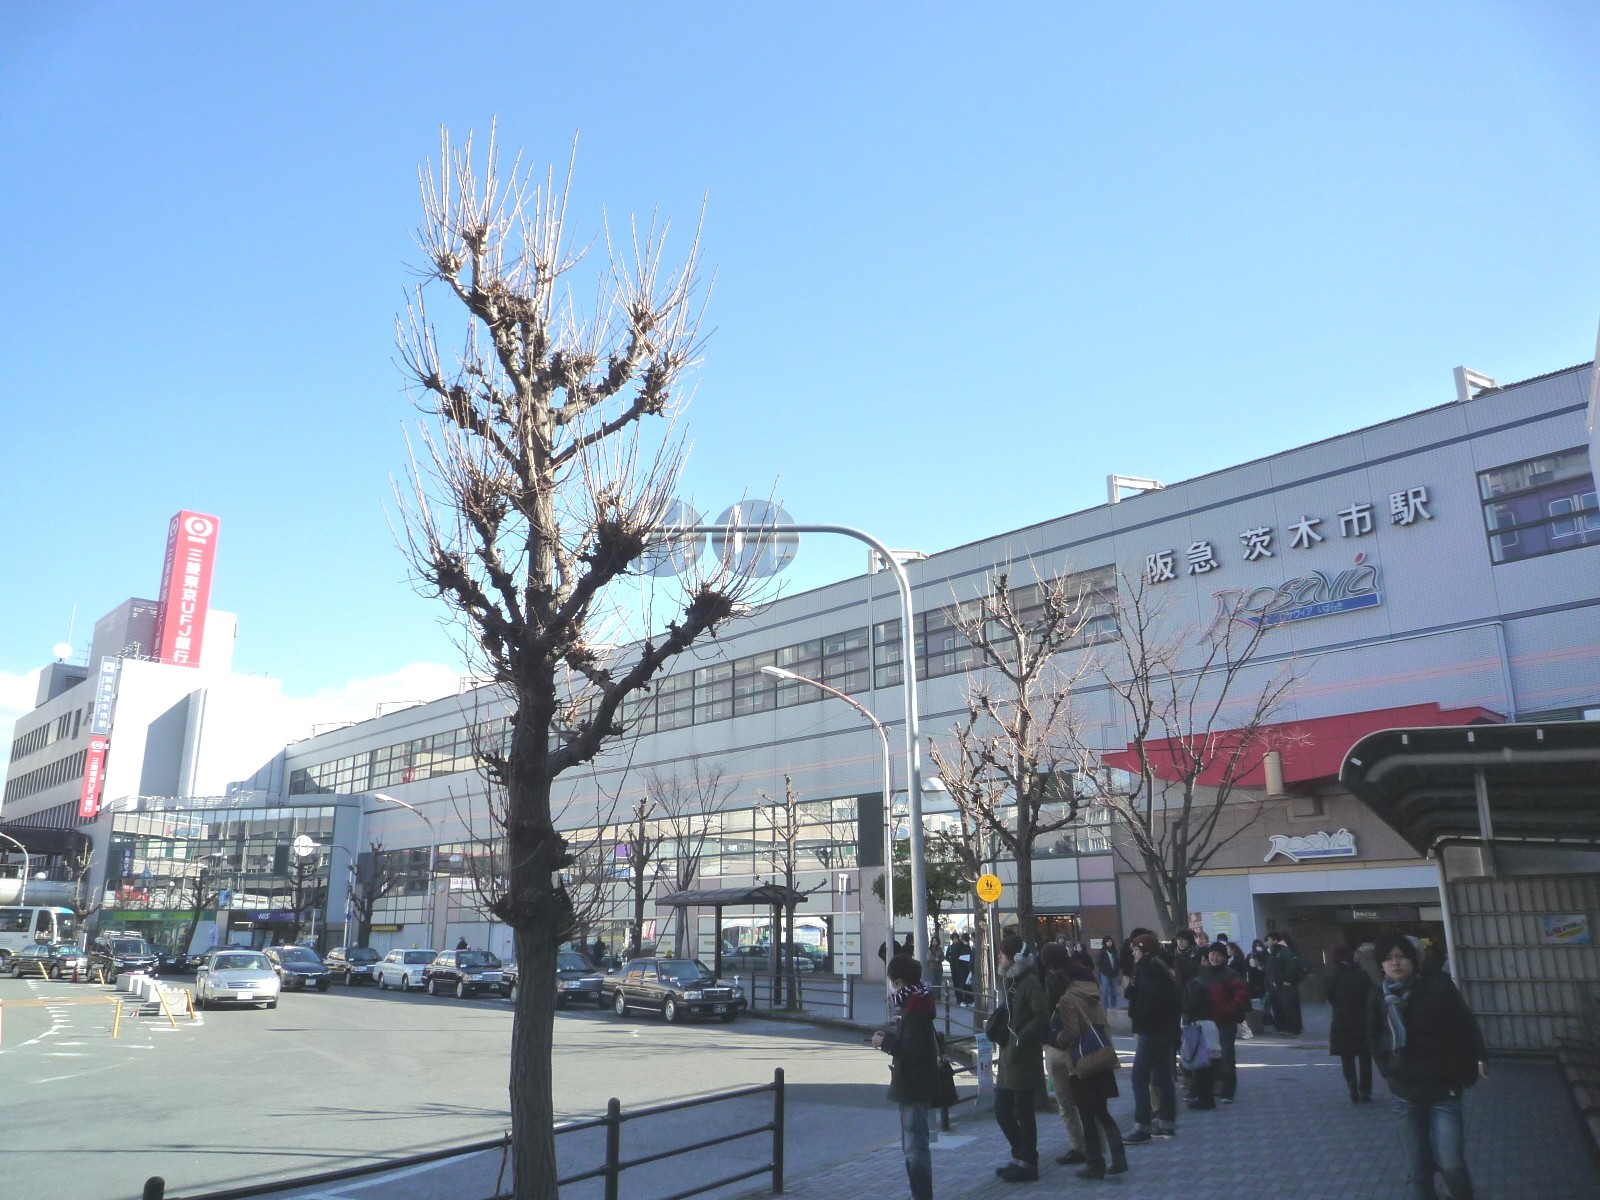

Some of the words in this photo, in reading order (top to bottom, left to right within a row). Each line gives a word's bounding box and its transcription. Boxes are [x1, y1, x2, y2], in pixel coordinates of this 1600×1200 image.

[173, 548, 203, 663] 三菱東京UFJ銀行
[1317, 602, 1343, 615] いばらき
